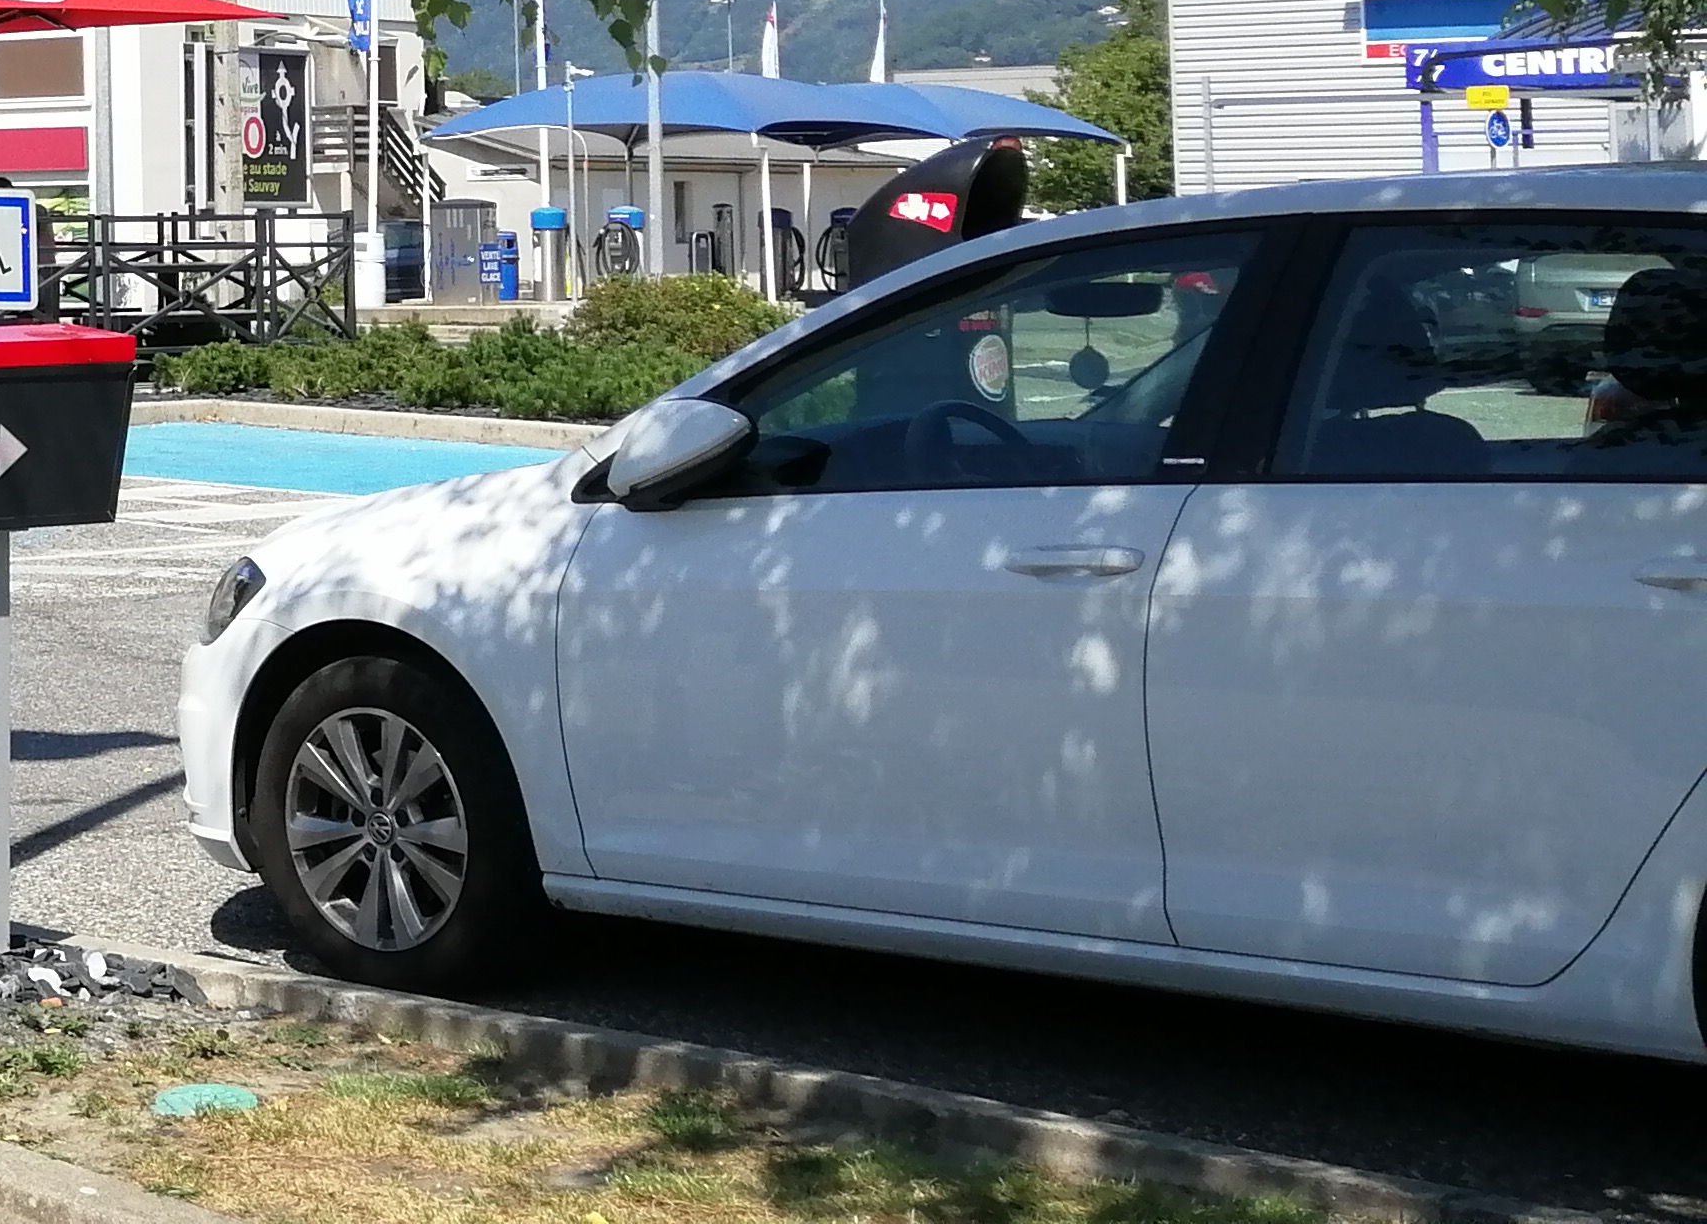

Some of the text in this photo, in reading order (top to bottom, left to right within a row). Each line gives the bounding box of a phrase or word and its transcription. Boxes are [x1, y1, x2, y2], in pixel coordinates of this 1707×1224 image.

[268, 143, 274, 155] 2
[249, 164, 261, 175] au
[263, 162, 287, 176] stade
[248, 179, 280, 196] Sauvay
